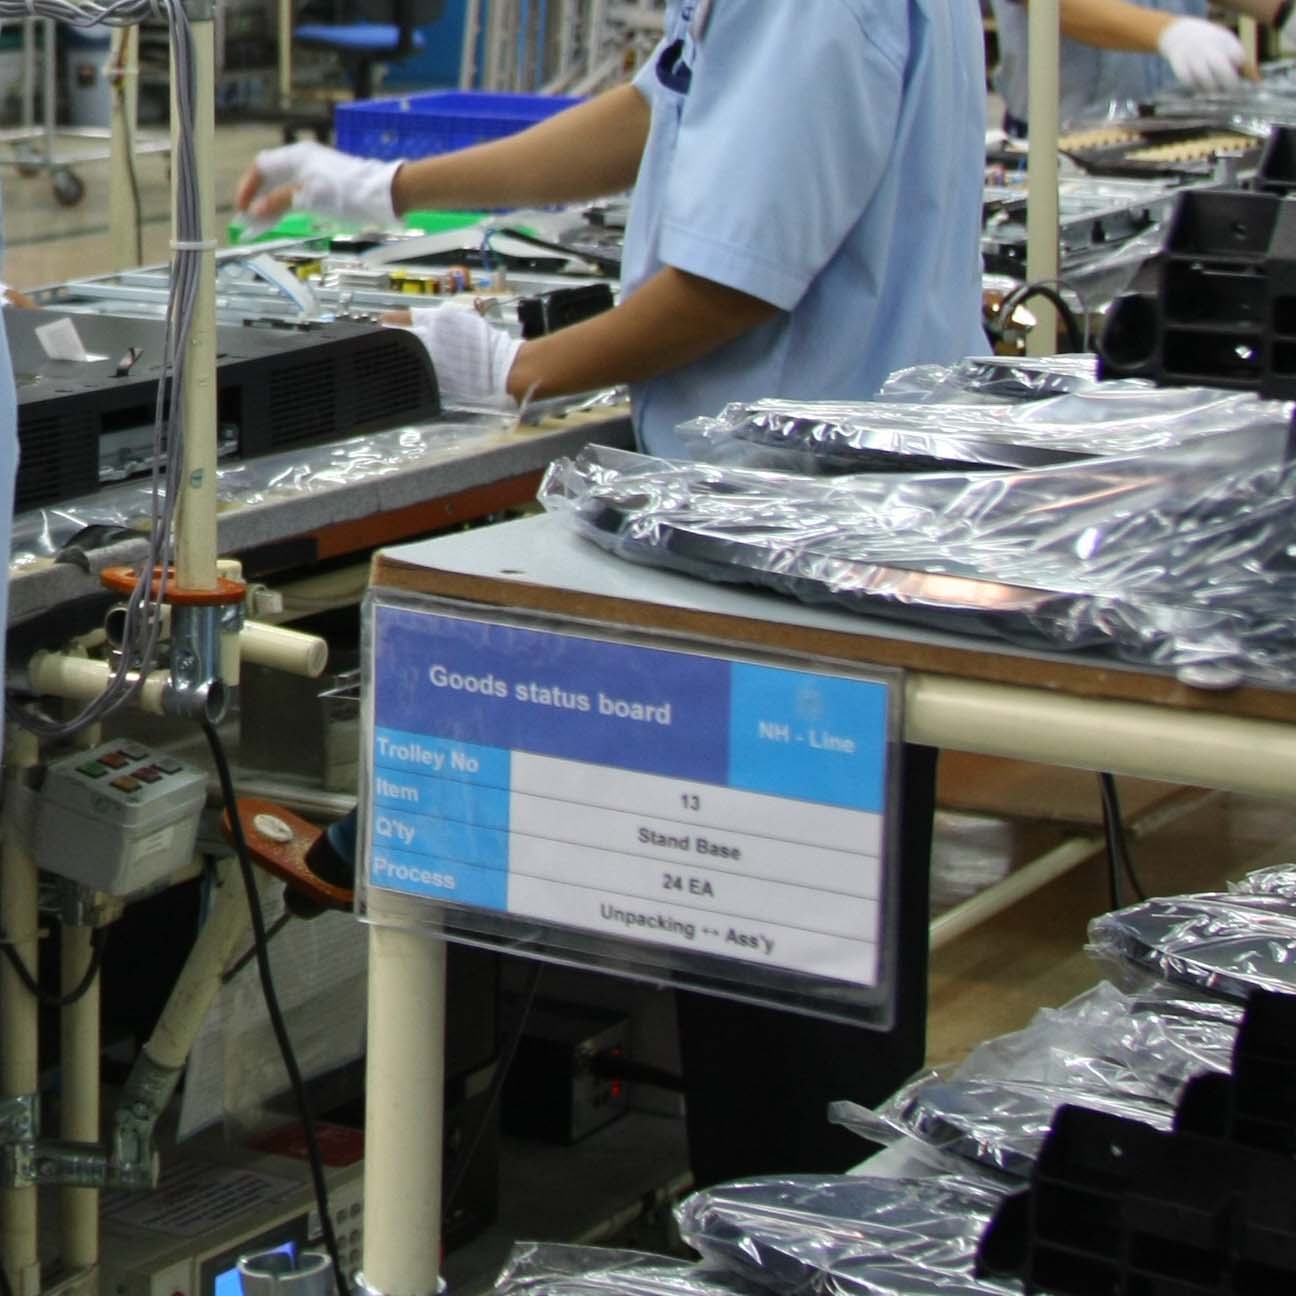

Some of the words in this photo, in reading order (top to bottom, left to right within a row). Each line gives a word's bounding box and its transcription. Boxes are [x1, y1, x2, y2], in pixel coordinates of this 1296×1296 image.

[429, 664, 508, 698] Goods
[515, 680, 591, 713] status
[599, 693, 672, 726] board
[759, 720, 790, 743] NH
[809, 729, 856, 754] Line
[376, 736, 445, 771] Trolley
[451, 750, 480, 773] No
[376, 776, 419, 803] Item
[680, 793, 701, 812] 13
[375, 816, 415, 846] Q'ty
[638, 827, 691, 852] Stand
[696, 838, 742, 861] Base
[373, 855, 456, 891] Process
[662, 873, 683, 892] 24
[688, 878, 715, 898] EA
[600, 903, 697, 941] Unpacking
[725, 927, 776, 955] Ass'y
